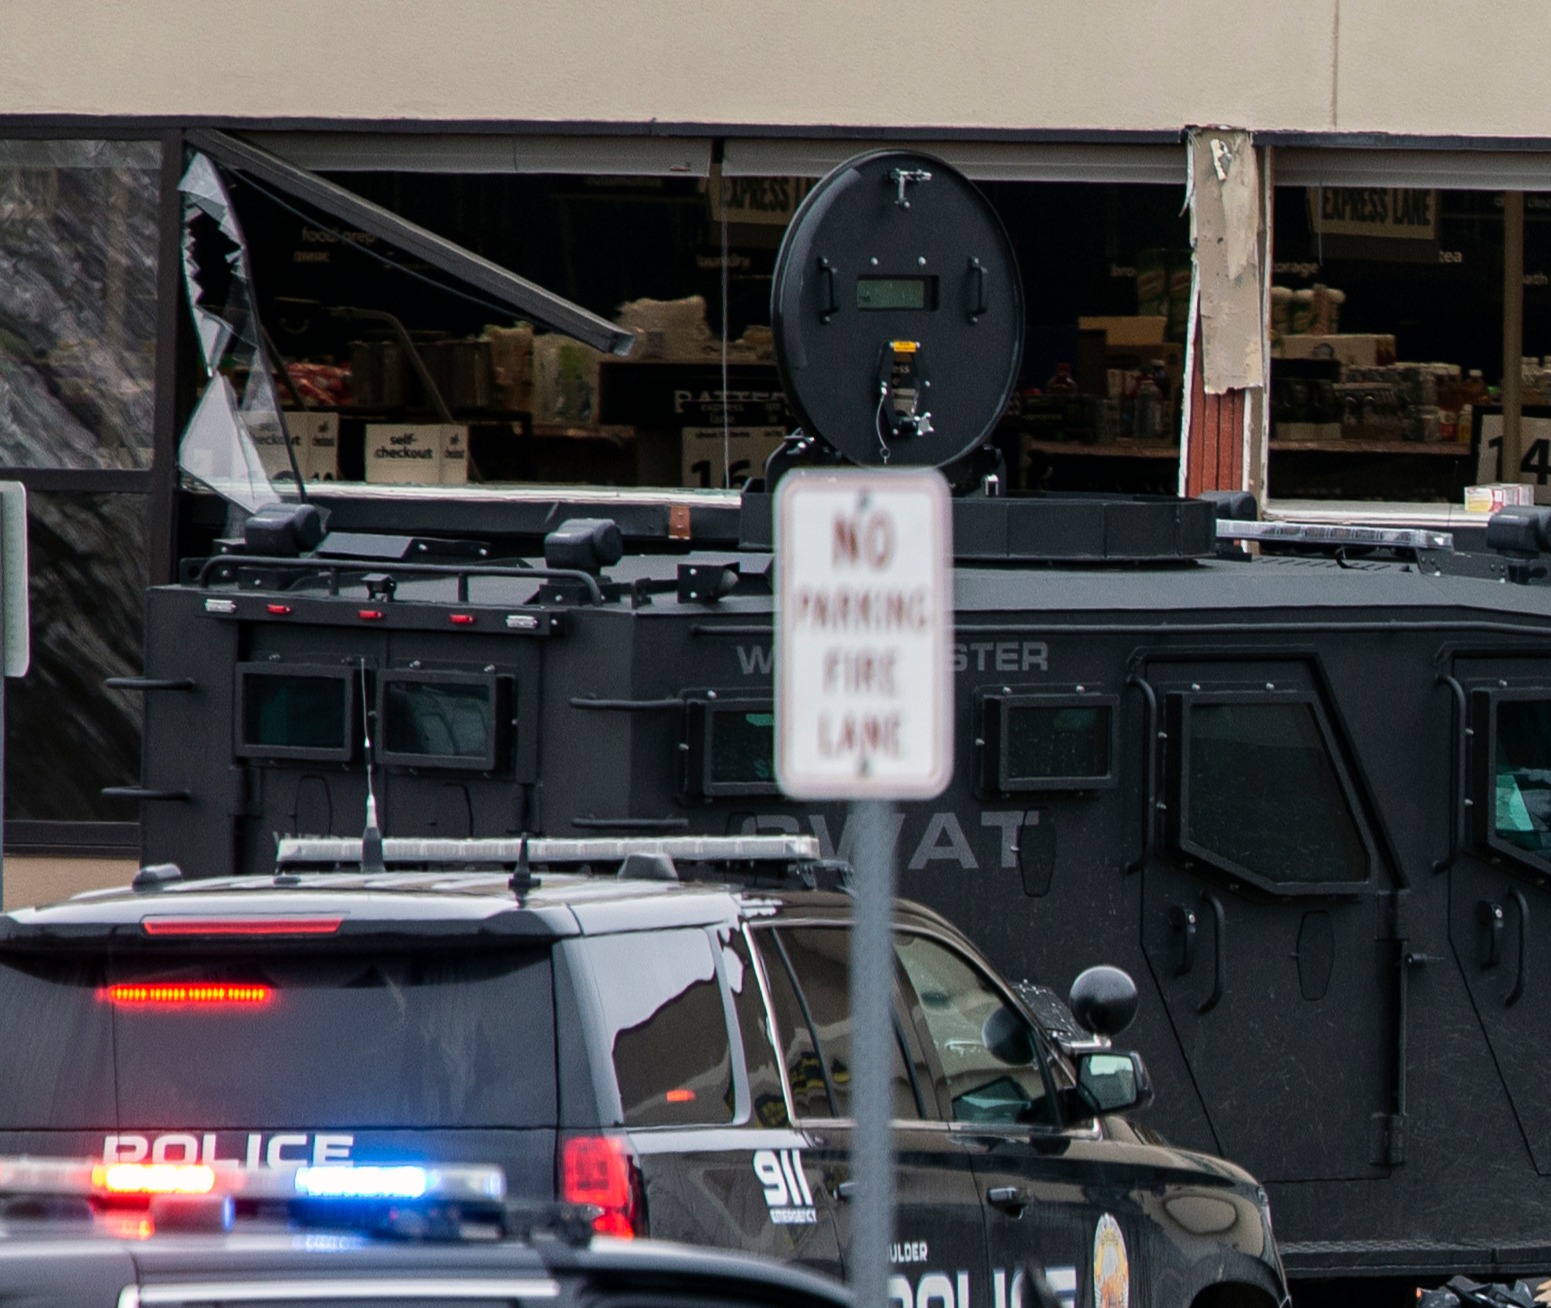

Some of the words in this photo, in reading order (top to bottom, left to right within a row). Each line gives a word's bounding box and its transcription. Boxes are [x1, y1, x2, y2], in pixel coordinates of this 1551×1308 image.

[1321, 187, 1388, 224] EXPRESS
[1392, 189, 1431, 226] LANE
[1110, 262, 1137, 278] bro
[1523, 272, 1548, 285] ath
[375, 446, 433, 460] checkout
[389, 433, 417, 446] self-
[831, 509, 899, 570] NO
[796, 586, 928, 634] PARKING
[822, 646, 900, 698] FIRE
[817, 708, 902, 760] LANE
[103, 1133, 355, 1171] POLICE
[753, 1148, 814, 1206] 911
[769, 1207, 818, 1225] EMERGENCY
[887, 1241, 929, 1264] ULDER
